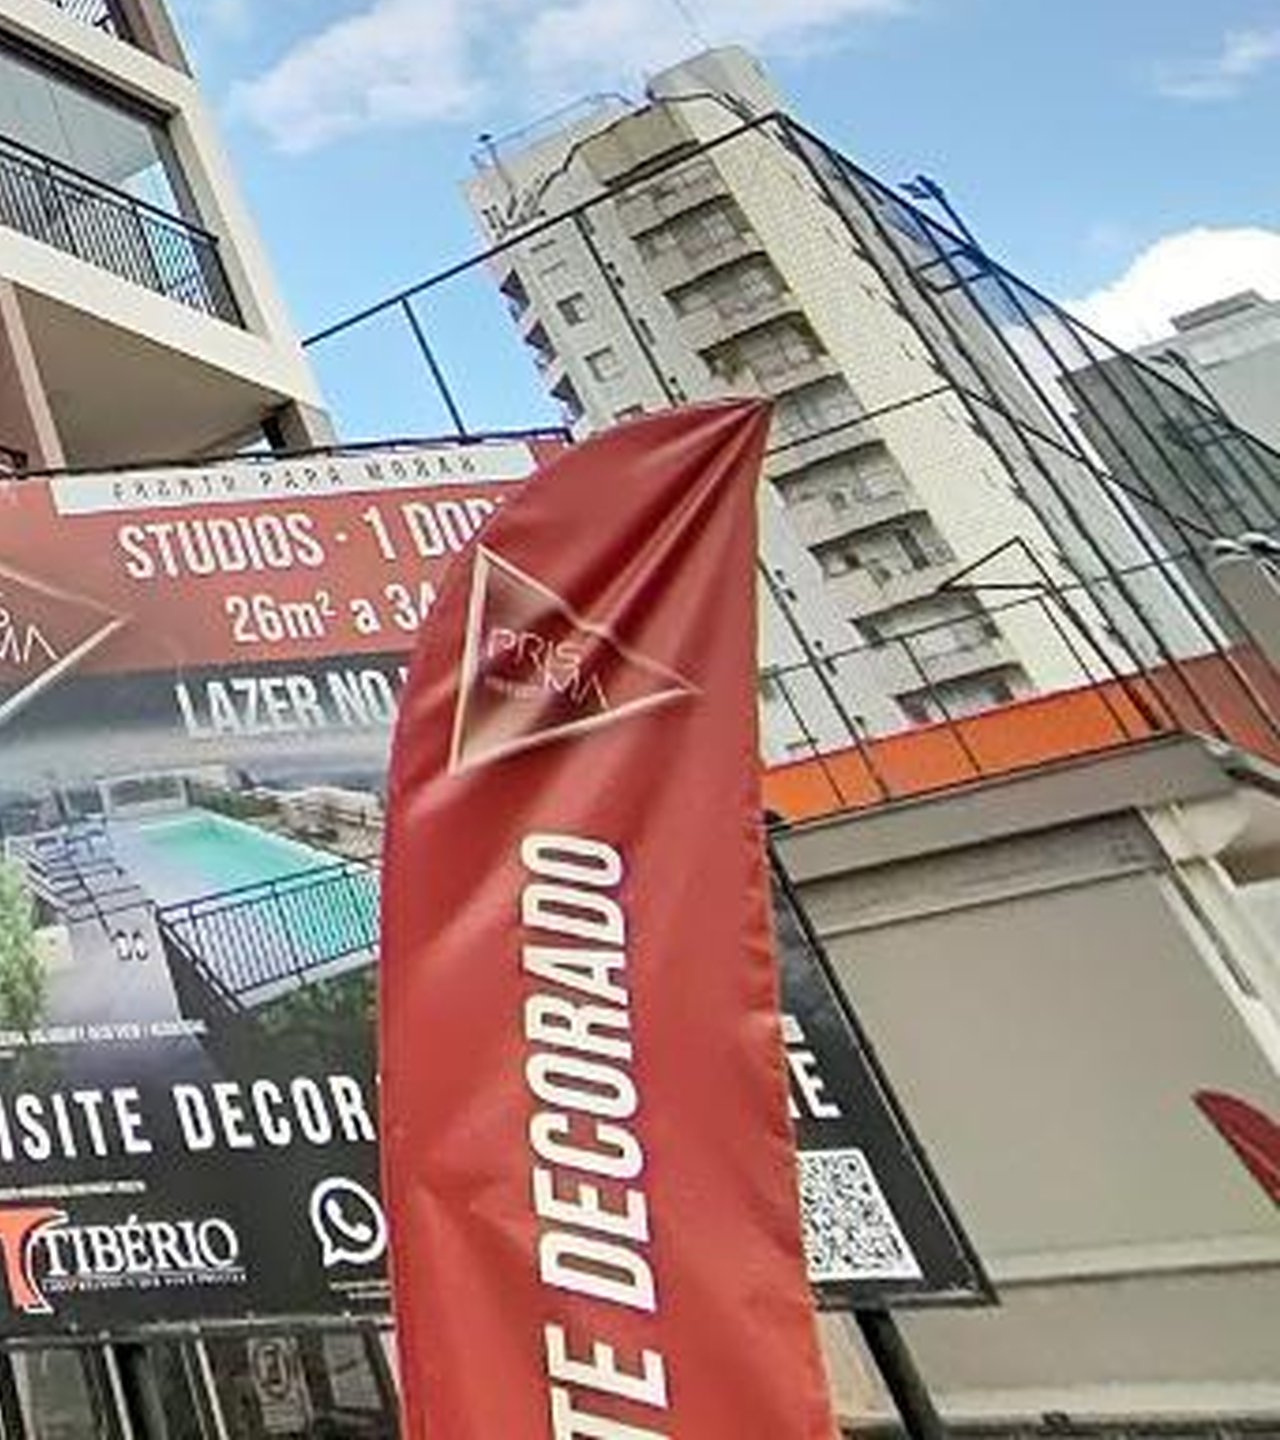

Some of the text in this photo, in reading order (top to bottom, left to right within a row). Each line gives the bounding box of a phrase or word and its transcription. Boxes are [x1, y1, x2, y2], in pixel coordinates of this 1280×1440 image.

[117, 511, 327, 579] STUDIOS
[361, 504, 397, 561] 1
[225, 590, 338, 644] 26m²
[349, 597, 382, 635] a
[486, 627, 583, 674] PRIS
[173, 668, 399, 741] LAZER NO
[543, 664, 610, 711] MA
[521, 833, 658, 1314] DECORADO
[172, 1073, 381, 1152] DECOR
[42, 1213, 241, 1278] TIBÉRIO
